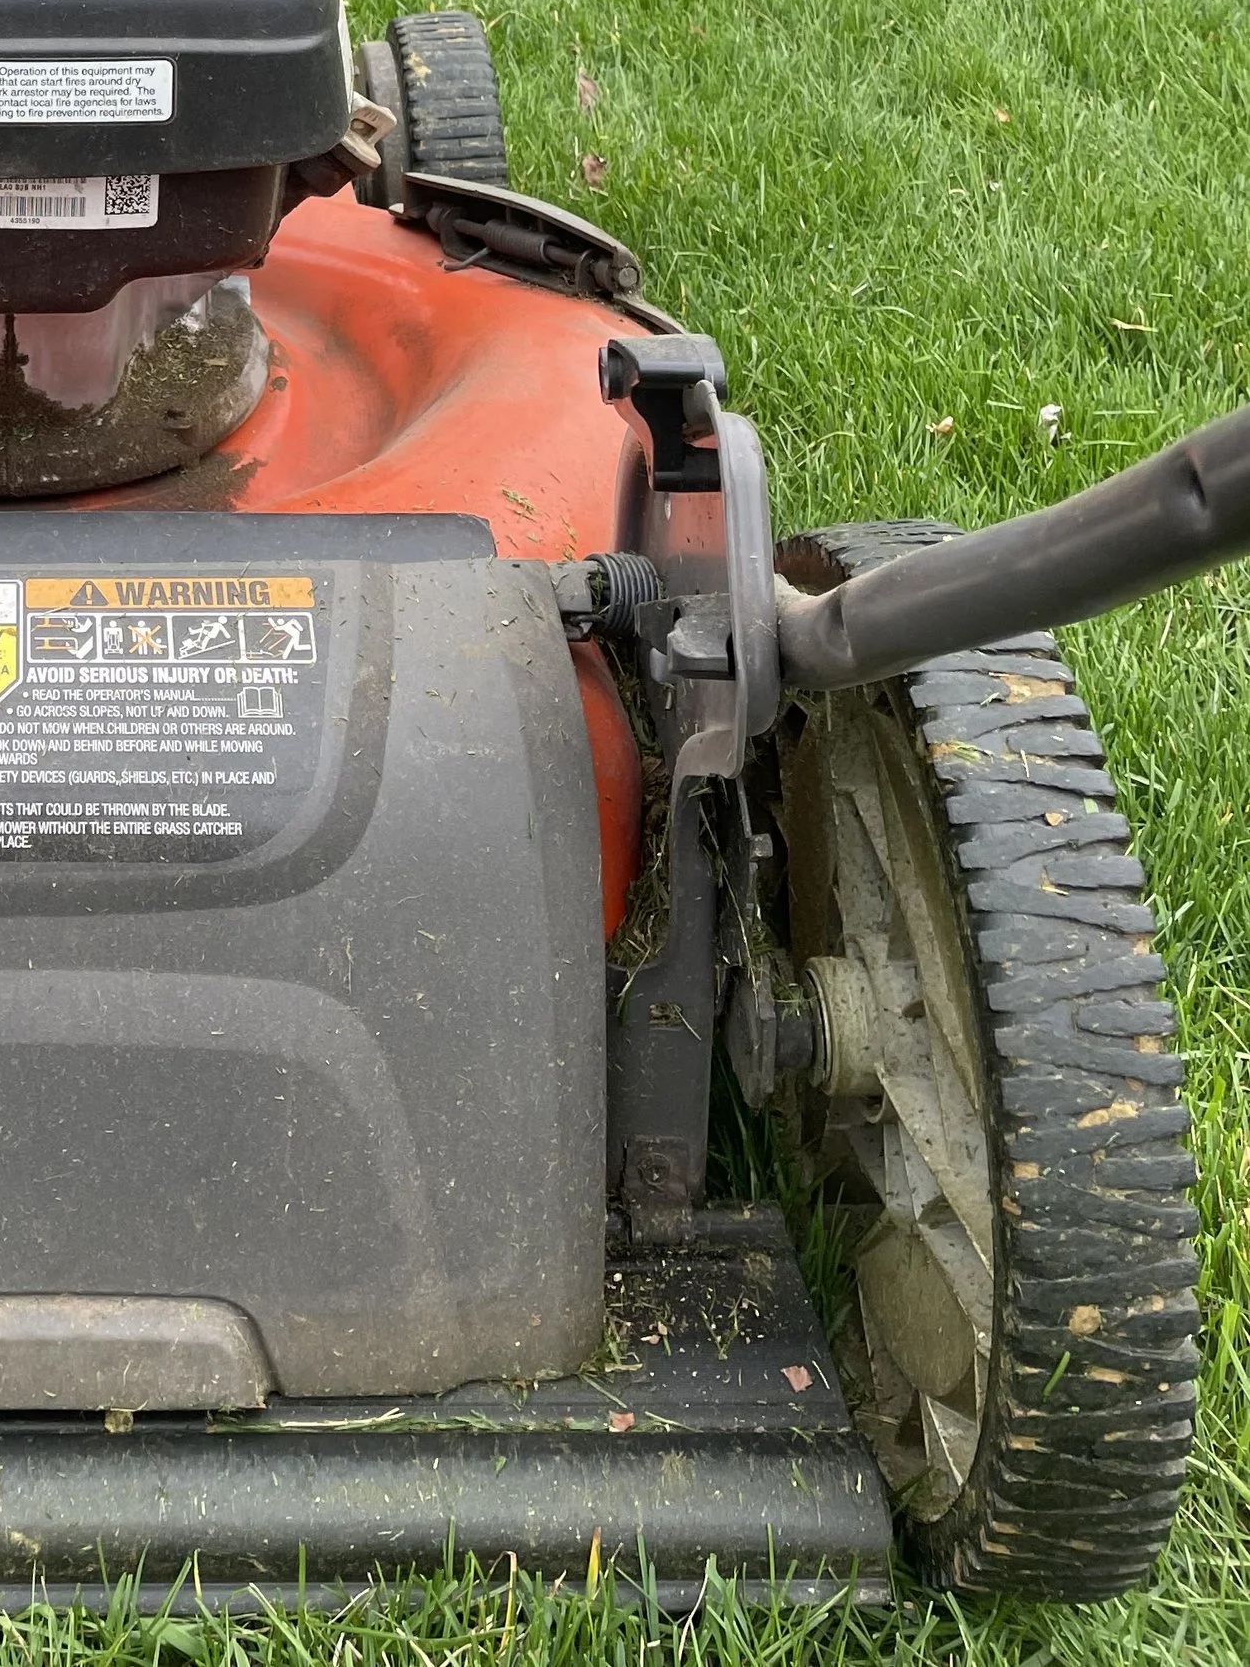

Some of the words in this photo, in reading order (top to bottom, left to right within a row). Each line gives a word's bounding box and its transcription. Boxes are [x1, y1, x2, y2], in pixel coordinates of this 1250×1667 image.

[50, 66, 59, 76] of
[62, 66, 79, 76] this
[82, 66, 132, 77] equipment
[134, 67, 156, 77] may
[20, 78, 38, 86] can
[40, 78, 63, 86] start
[65, 77, 86, 86] fires
[88, 77, 123, 86] around
[125, 77, 141, 88] dry
[10, 88, 49, 96] arrestor
[52, 89, 72, 98] may
[74, 88, 86, 96] be
[90, 88, 132, 98] required.
[136, 87, 156, 95] The
[30, 98, 53, 107] local
[56, 98, 71, 107] fire
[74, 98, 117, 108] agencies
[120, 98, 132, 106] for
[135, 97, 157, 106] laws
[16, 109, 26, 117] to
[28, 108, 44, 117] fire
[46, 108, 97, 119] prevention
[99, 108, 164, 118] requirements.
[114, 580, 271, 606] WARNING
[26, 667, 75, 684] AVOID
[79, 667, 149, 684] SERIOUS
[152, 667, 210, 684] INJURY
[214, 667, 238, 684] OR
[241, 667, 299, 684] DEATH:
[32, 689, 61, 701] READ
[62, 689, 84, 701] THE
[86, 689, 151, 701] OPERATOR'S
[16, 706, 32, 718] GO
[34, 706, 77, 718] ACROSS
[79, 706, 124, 719] SLOPES,
[126, 706, 148, 718] NOT
[167, 706, 189, 718] AND
[192, 706, 230, 718] DOWN.
[17, 722, 40, 734] NOT
[42, 722, 71, 734] MOW
[73, 722, 104, 734] WHEN
[106, 723, 160, 735] CHILDREN
[162, 723, 178, 735] OR
[180, 723, 223, 735] OTHERS
[225, 723, 247, 735] ARE
[247, 723, 296, 735] AROUND.
[12, 739, 46, 752] DOWN
[48, 739, 71, 752] AND
[73, 739, 114, 752] BEHIND
[116, 740, 158, 752] BEFORE
[159, 740, 182, 752] AND
[184, 740, 218, 752] WHILE
[220, 740, 263, 753] MOVING
[21, 770, 66, 784] DEVICES
[121, 770, 170, 786] SHIELDS,
[172, 771, 199, 787] ETC.)
[202, 770, 212, 784] IN
[215, 770, 250, 784] PLACE
[251, 770, 275, 784] AND
[16, 803, 44, 816] THAT
[46, 803, 83, 816] COULD
[85, 803, 100, 816] BE
[102, 803, 150, 816] THROWN
[152, 803, 166, 816] BY
[168, 803, 190, 816] THE
[192, 803, 231, 816] BLADE.
[38, 821, 88, 834] WITHOUT
[90, 821, 111, 834] THE
[113, 821, 151, 834] ENTIRE
[154, 822, 190, 835] GRASS
[193, 822, 242, 835] CATCHER
